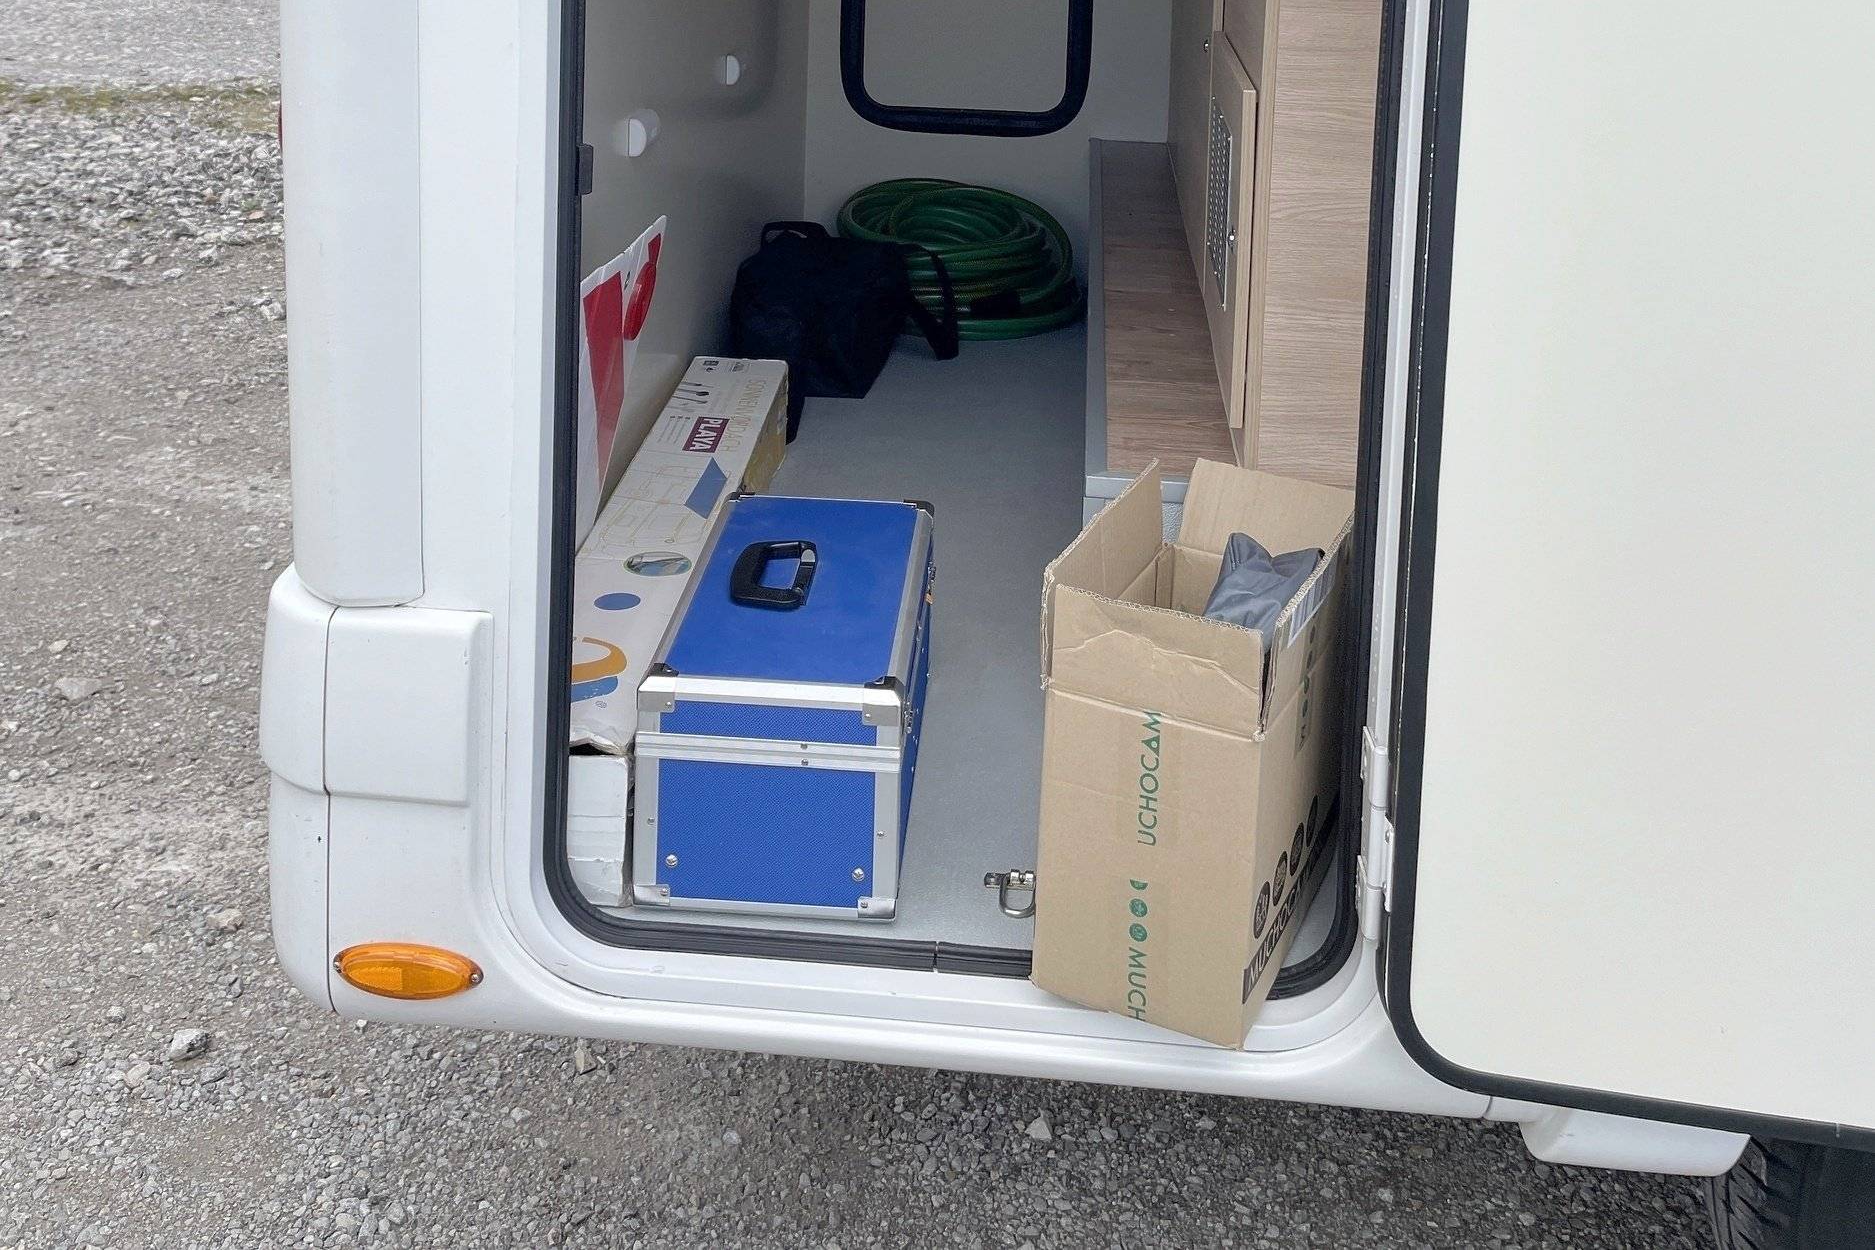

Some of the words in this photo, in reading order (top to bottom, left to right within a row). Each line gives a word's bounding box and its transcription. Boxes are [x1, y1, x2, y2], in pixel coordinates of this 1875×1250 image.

[689, 417, 723, 452] PLAYA
[1137, 710, 1162, 846] UCHOCAM
[1127, 947, 1147, 1022] MUCH
